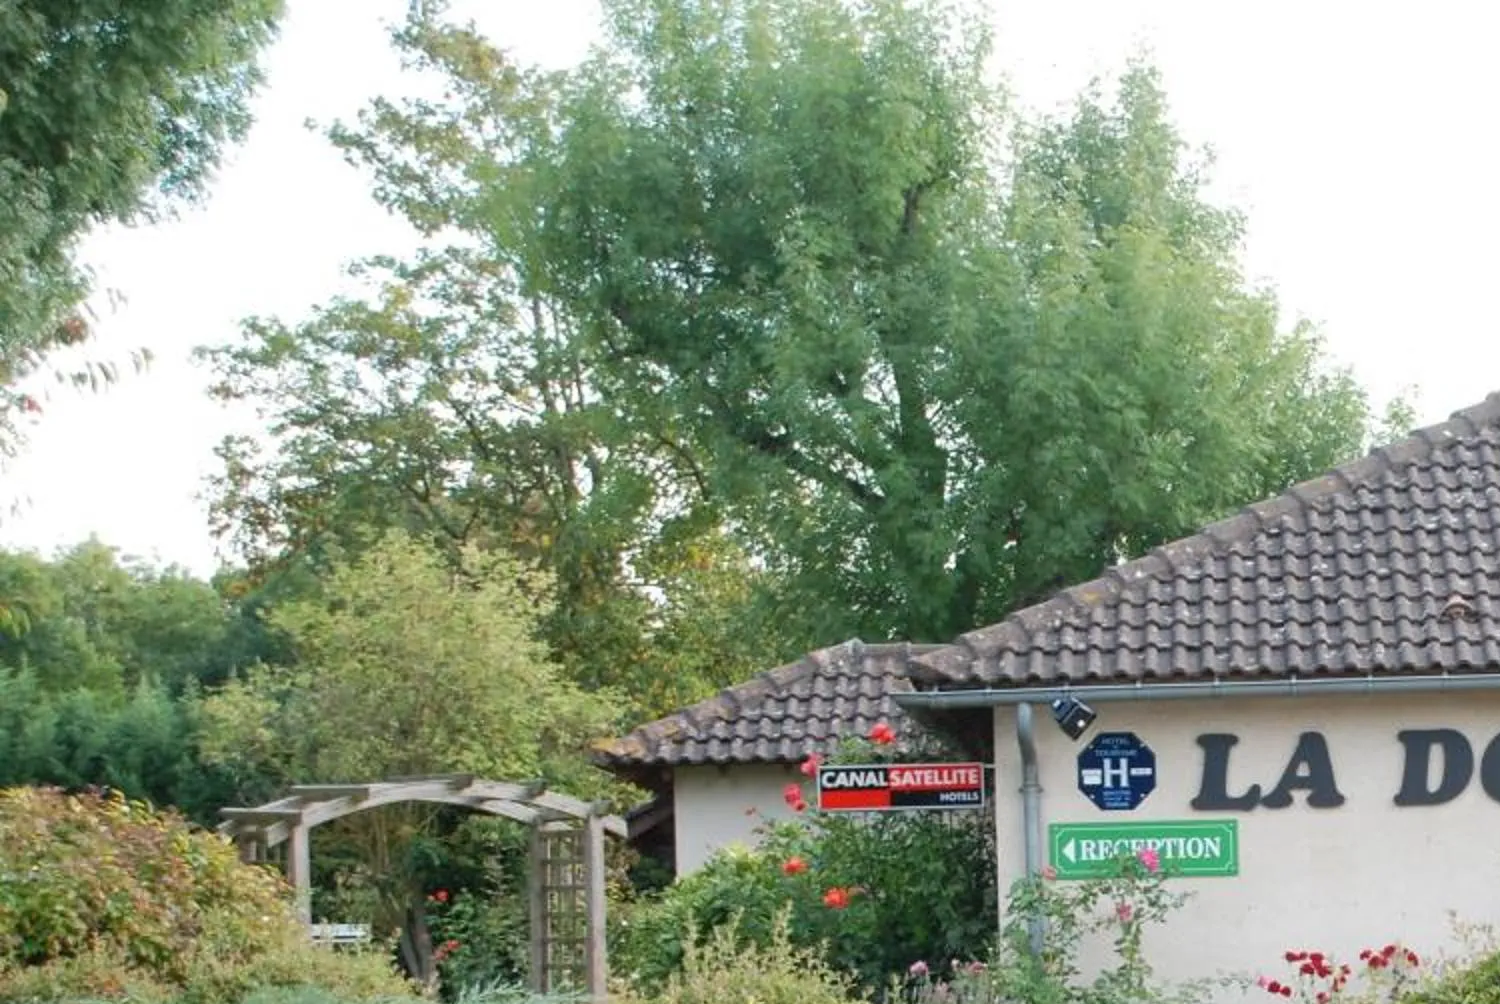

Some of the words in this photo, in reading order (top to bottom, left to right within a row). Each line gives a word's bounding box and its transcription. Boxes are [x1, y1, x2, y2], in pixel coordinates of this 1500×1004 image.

[821, 770, 888, 787] CANAL
[890, 769, 978, 786] SATELLITE
[1103, 758, 1129, 788] H
[1190, 731, 1345, 812] LA
[940, 792, 979, 801] HOTELS
